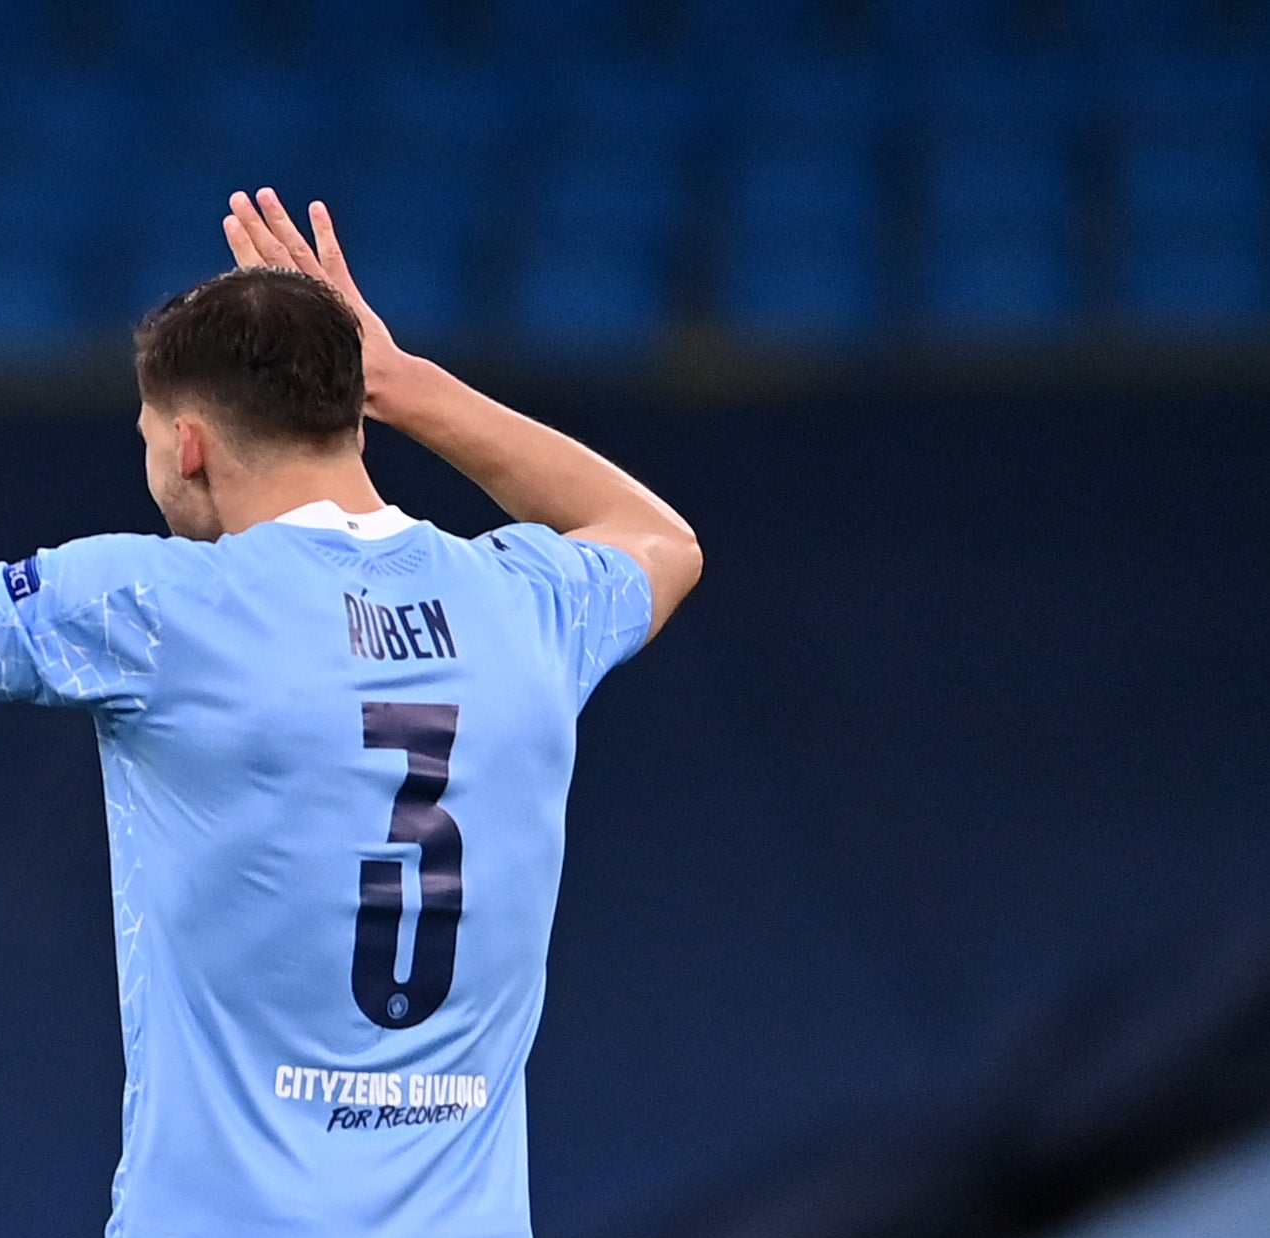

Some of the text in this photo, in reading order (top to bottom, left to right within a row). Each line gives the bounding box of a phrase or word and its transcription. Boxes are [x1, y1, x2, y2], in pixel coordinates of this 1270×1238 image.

[343, 587, 457, 661] RÚBEN
[351, 700, 464, 1031] 3
[275, 1064, 488, 1109] CITYZENS GIVING
